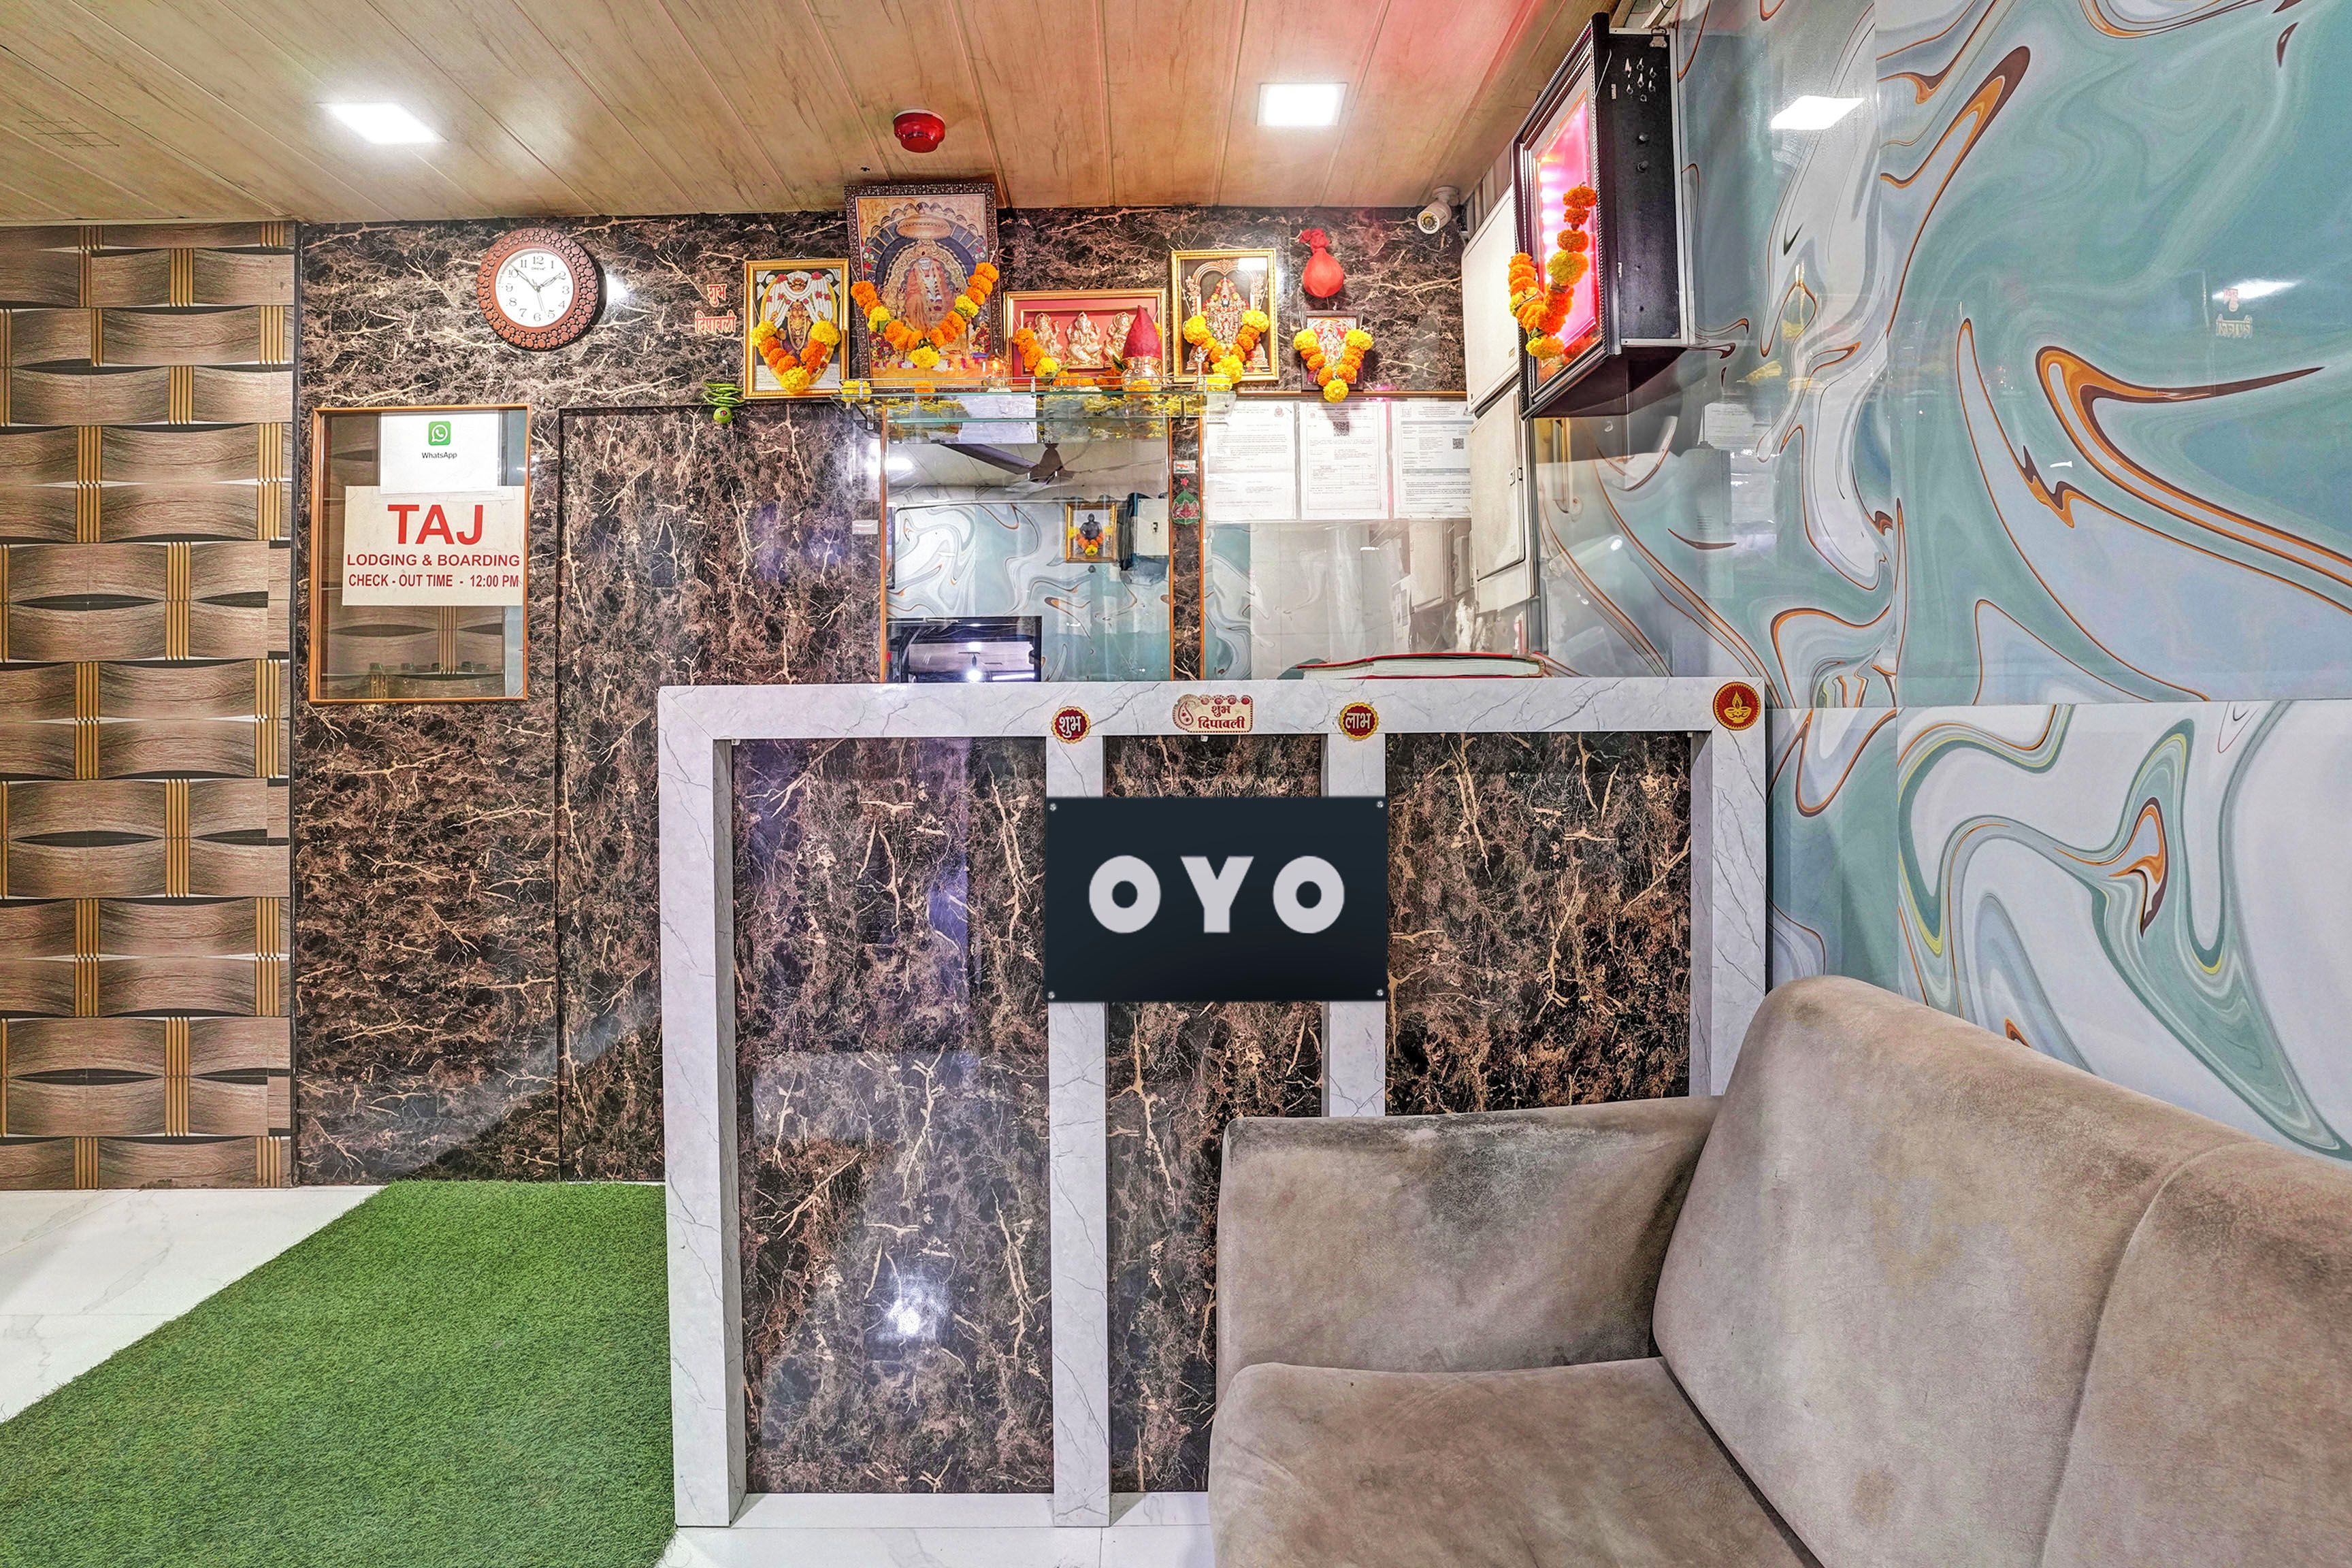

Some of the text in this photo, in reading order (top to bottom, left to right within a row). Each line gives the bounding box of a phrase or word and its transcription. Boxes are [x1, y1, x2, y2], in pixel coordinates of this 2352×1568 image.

[521, 259, 527, 268] 11
[533, 256, 544, 265] 12
[551, 260, 555, 269] 1
[508, 270, 519, 278] 10
[559, 271, 566, 280] 2
[506, 283, 513, 292] 9
[562, 286, 570, 294] 3
[706, 284, 728, 308] शुभ
[509, 297, 517, 306] 8
[519, 308, 527, 317] 7
[548, 310, 555, 318] 5
[533, 313, 541, 322] 6
[387, 504, 483, 545] TAJ
[347, 554, 520, 567] LODGING & BOARDING
[348, 574, 389, 587] CHECK
[399, 574, 423, 587] OUT
[426, 574, 453, 587] TIME
[470, 575, 499, 587] 12:00
[502, 575, 519, 587] PM
[1211, 705, 1231, 717] शुभ
[1198, 715, 1245, 729] दिपावली
[1345, 713, 1372, 730] लाभ
[1058, 716, 1081, 738] शुभ
[1089, 855, 1345, 934] OYO
